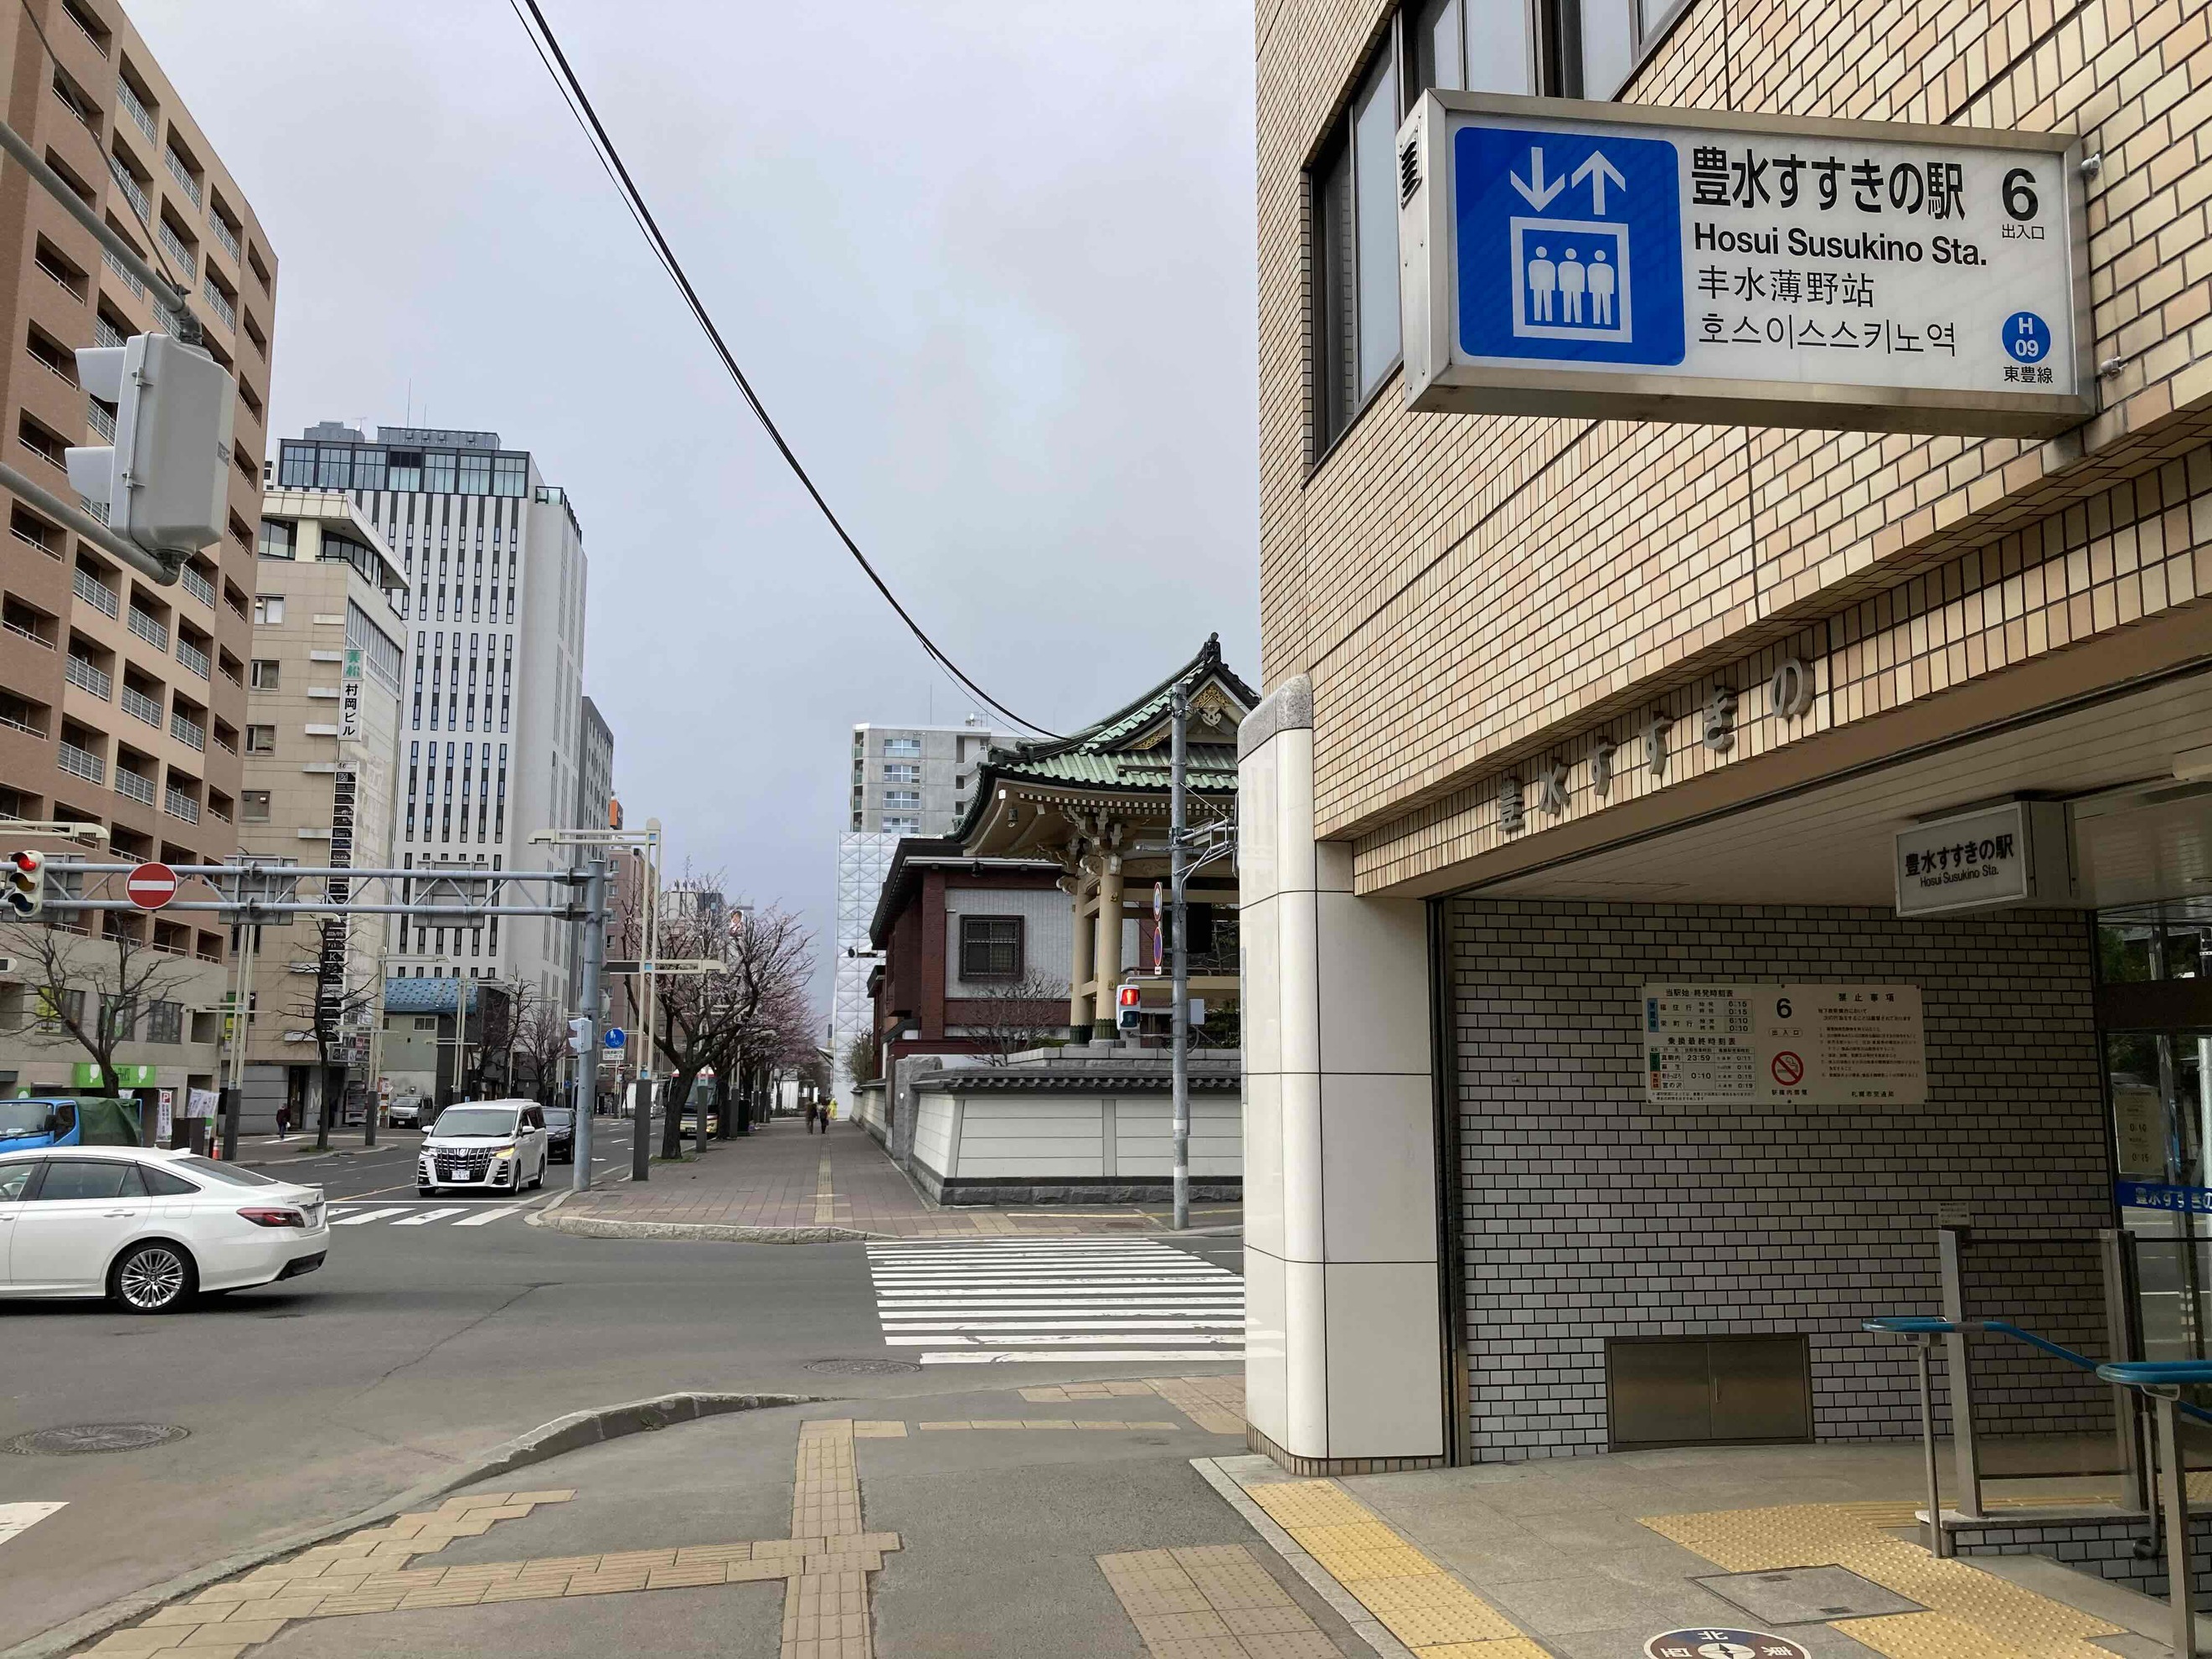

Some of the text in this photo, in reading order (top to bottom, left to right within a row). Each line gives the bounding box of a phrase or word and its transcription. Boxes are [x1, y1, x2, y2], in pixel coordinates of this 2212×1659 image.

[1691, 145, 1967, 220] 豊水すすきの駅
[2001, 167, 2039, 221] 6
[1694, 222, 1988, 266] Hosui Susukino Sta.
[2001, 223, 2045, 241] 出入口
[1697, 265, 1875, 308] 丰水薄野站
[1699, 313, 1957, 357] 호스이스스키노역
[2018, 317, 2034, 335] H
[2014, 337, 2039, 358] 09
[2003, 364, 2055, 384] 東豊線
[342, 683, 358, 737] 村岡ビル
[1497, 656, 1816, 832] 豊水すすきの
[1905, 832, 2014, 877] 豊水すすきの駅
[1920, 865, 1999, 888] Hosui Susukino Sta.
[1776, 998, 1794, 1019] 6
[1838, 992, 1895, 1002] 禁止事項
[1698, 1631, 1729, 1641] 北
